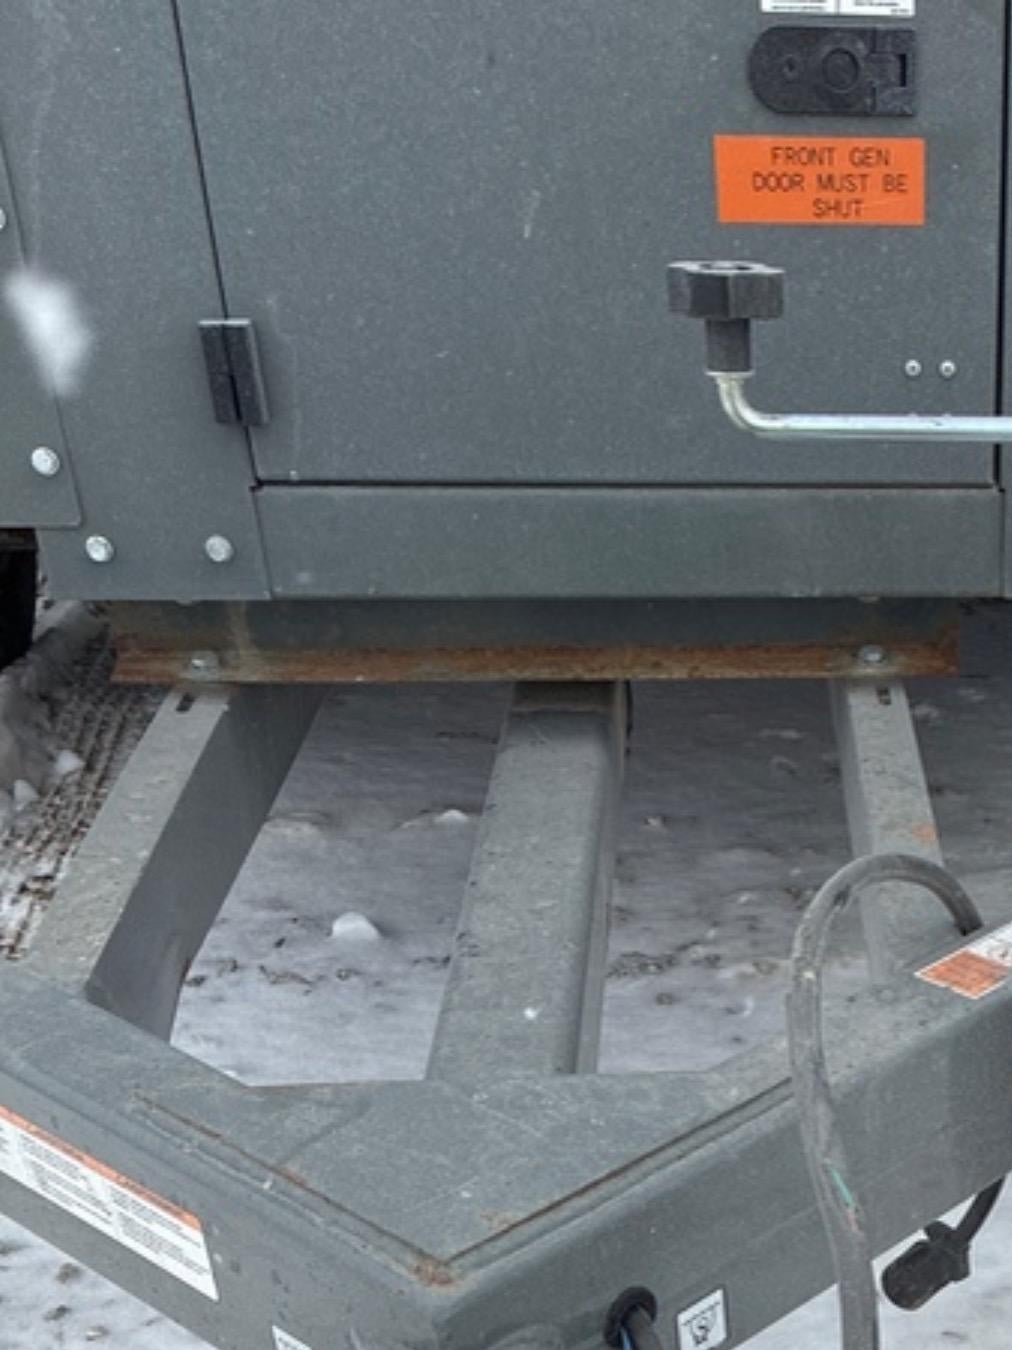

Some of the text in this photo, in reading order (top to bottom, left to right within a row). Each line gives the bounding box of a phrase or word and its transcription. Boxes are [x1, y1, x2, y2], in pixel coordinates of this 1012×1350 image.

[770, 146, 890, 168] FRONT GEN
[752, 171, 908, 194] DOOR MUST BE
[812, 197, 865, 219] SHUT
